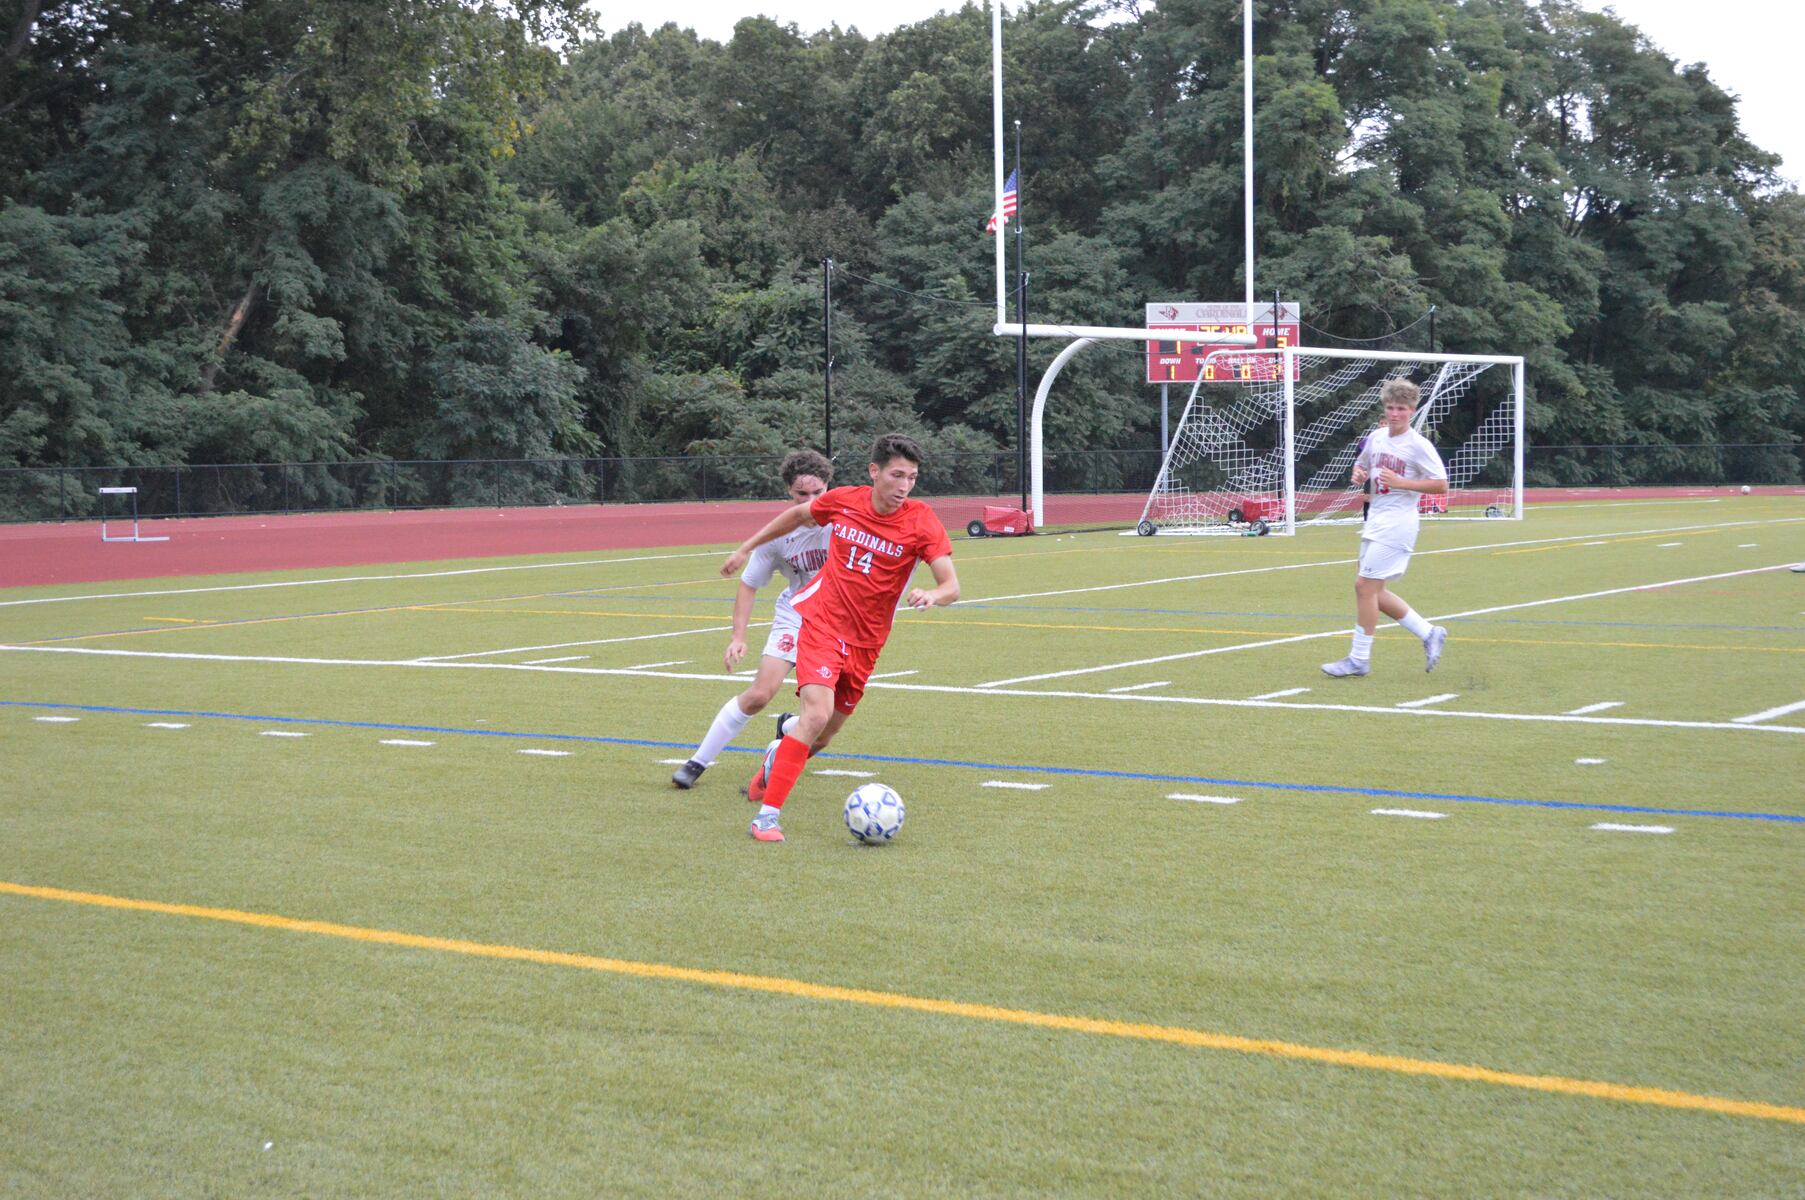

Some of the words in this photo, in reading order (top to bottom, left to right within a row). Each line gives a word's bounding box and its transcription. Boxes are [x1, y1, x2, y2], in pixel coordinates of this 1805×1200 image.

[1196, 309, 1248, 319] CARDINAL
[1262, 328, 1291, 337] HOME
[1159, 357, 1182, 365] DOWN
[1205, 364, 1214, 380] 0
[834, 523, 904, 557] CARDINALS
[846, 545, 874, 574] 14
